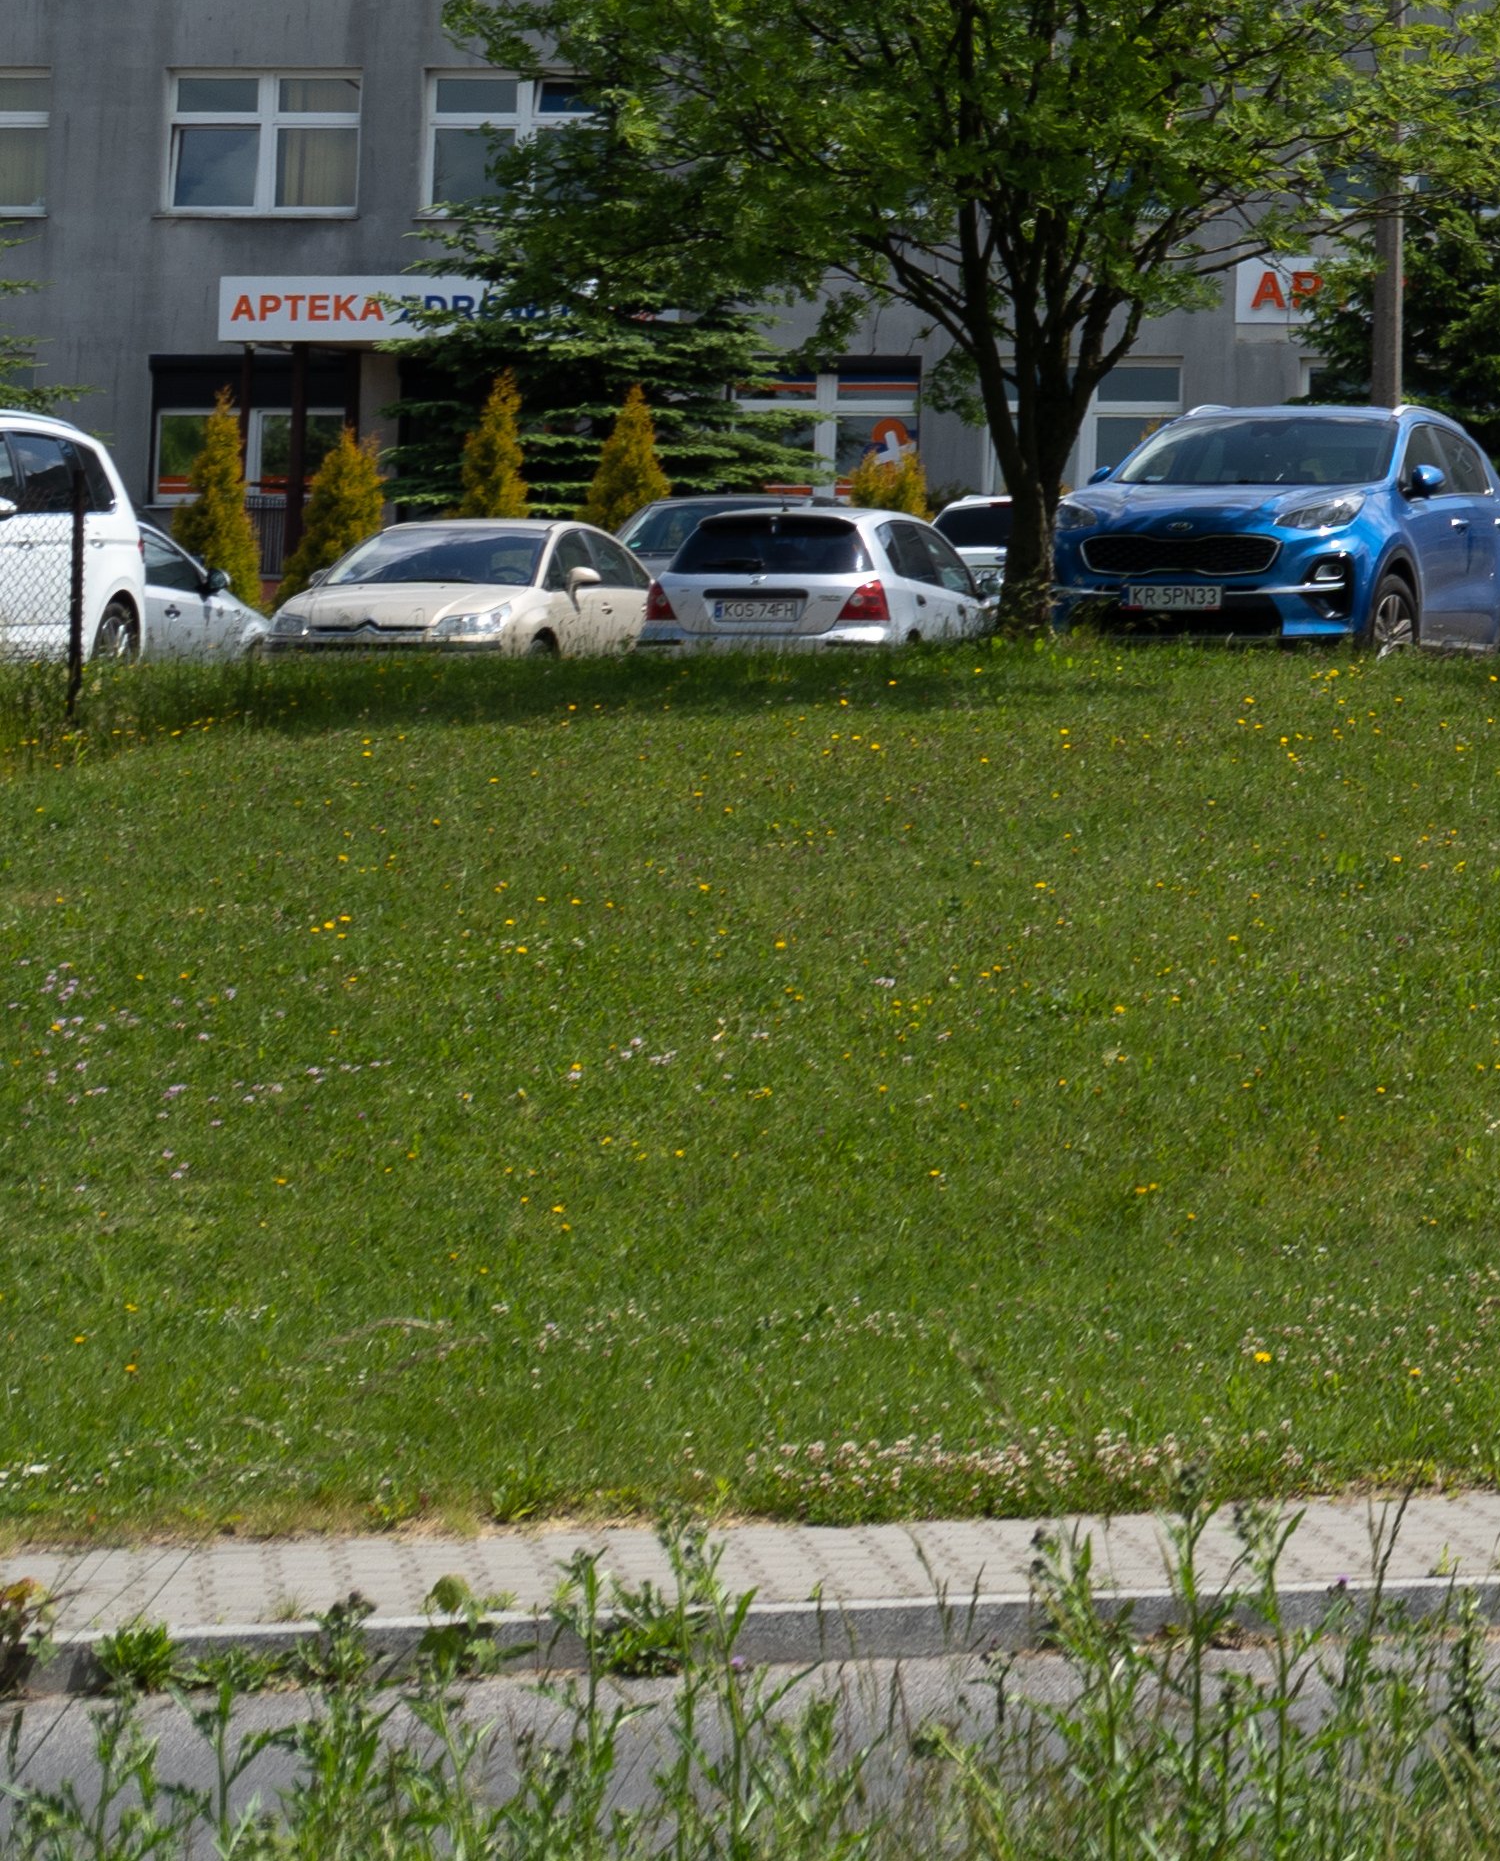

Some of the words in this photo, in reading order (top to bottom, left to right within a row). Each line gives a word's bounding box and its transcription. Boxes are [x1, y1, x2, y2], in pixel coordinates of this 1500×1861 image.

[230, 294, 386, 322] APTEKA
[1132, 587, 1156, 605] KR
[1162, 587, 1217, 605] 5PN33
[724, 603, 751, 618] KOS
[759, 603, 795, 618] 74FH
